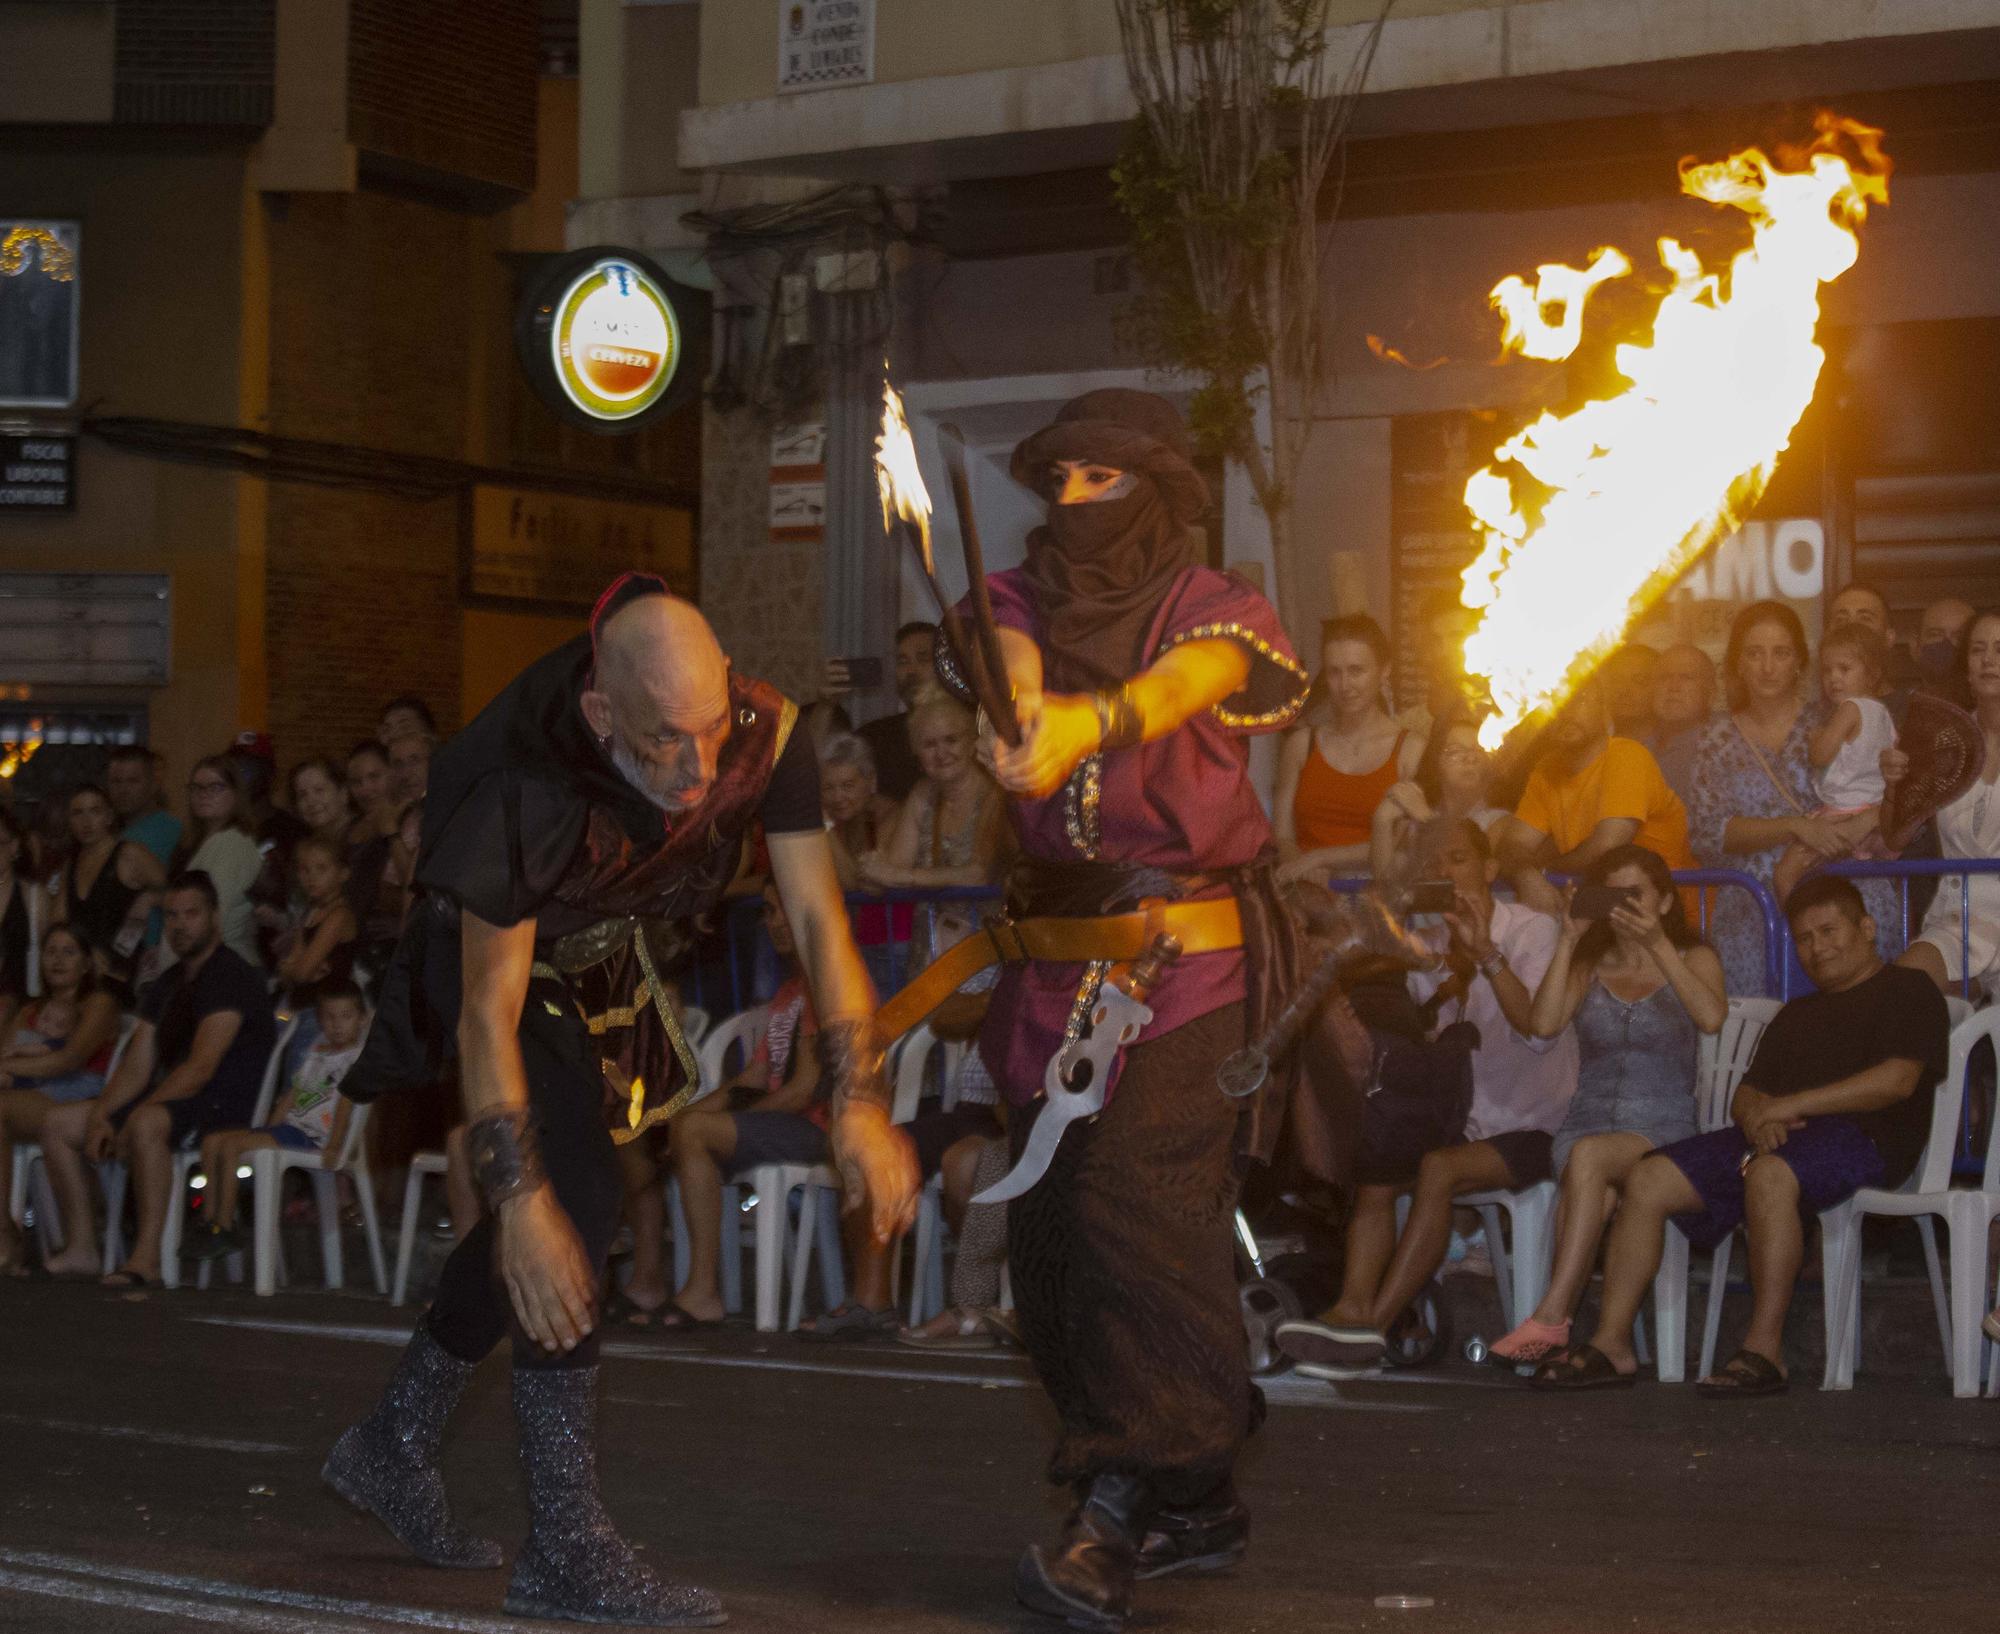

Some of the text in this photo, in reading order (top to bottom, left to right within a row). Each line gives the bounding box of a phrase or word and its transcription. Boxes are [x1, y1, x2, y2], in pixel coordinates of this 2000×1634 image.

[589, 348, 651, 369] CERVEZA
[22, 442, 66, 460] FISCAL
[0, 489, 66, 505] CONTABLE
